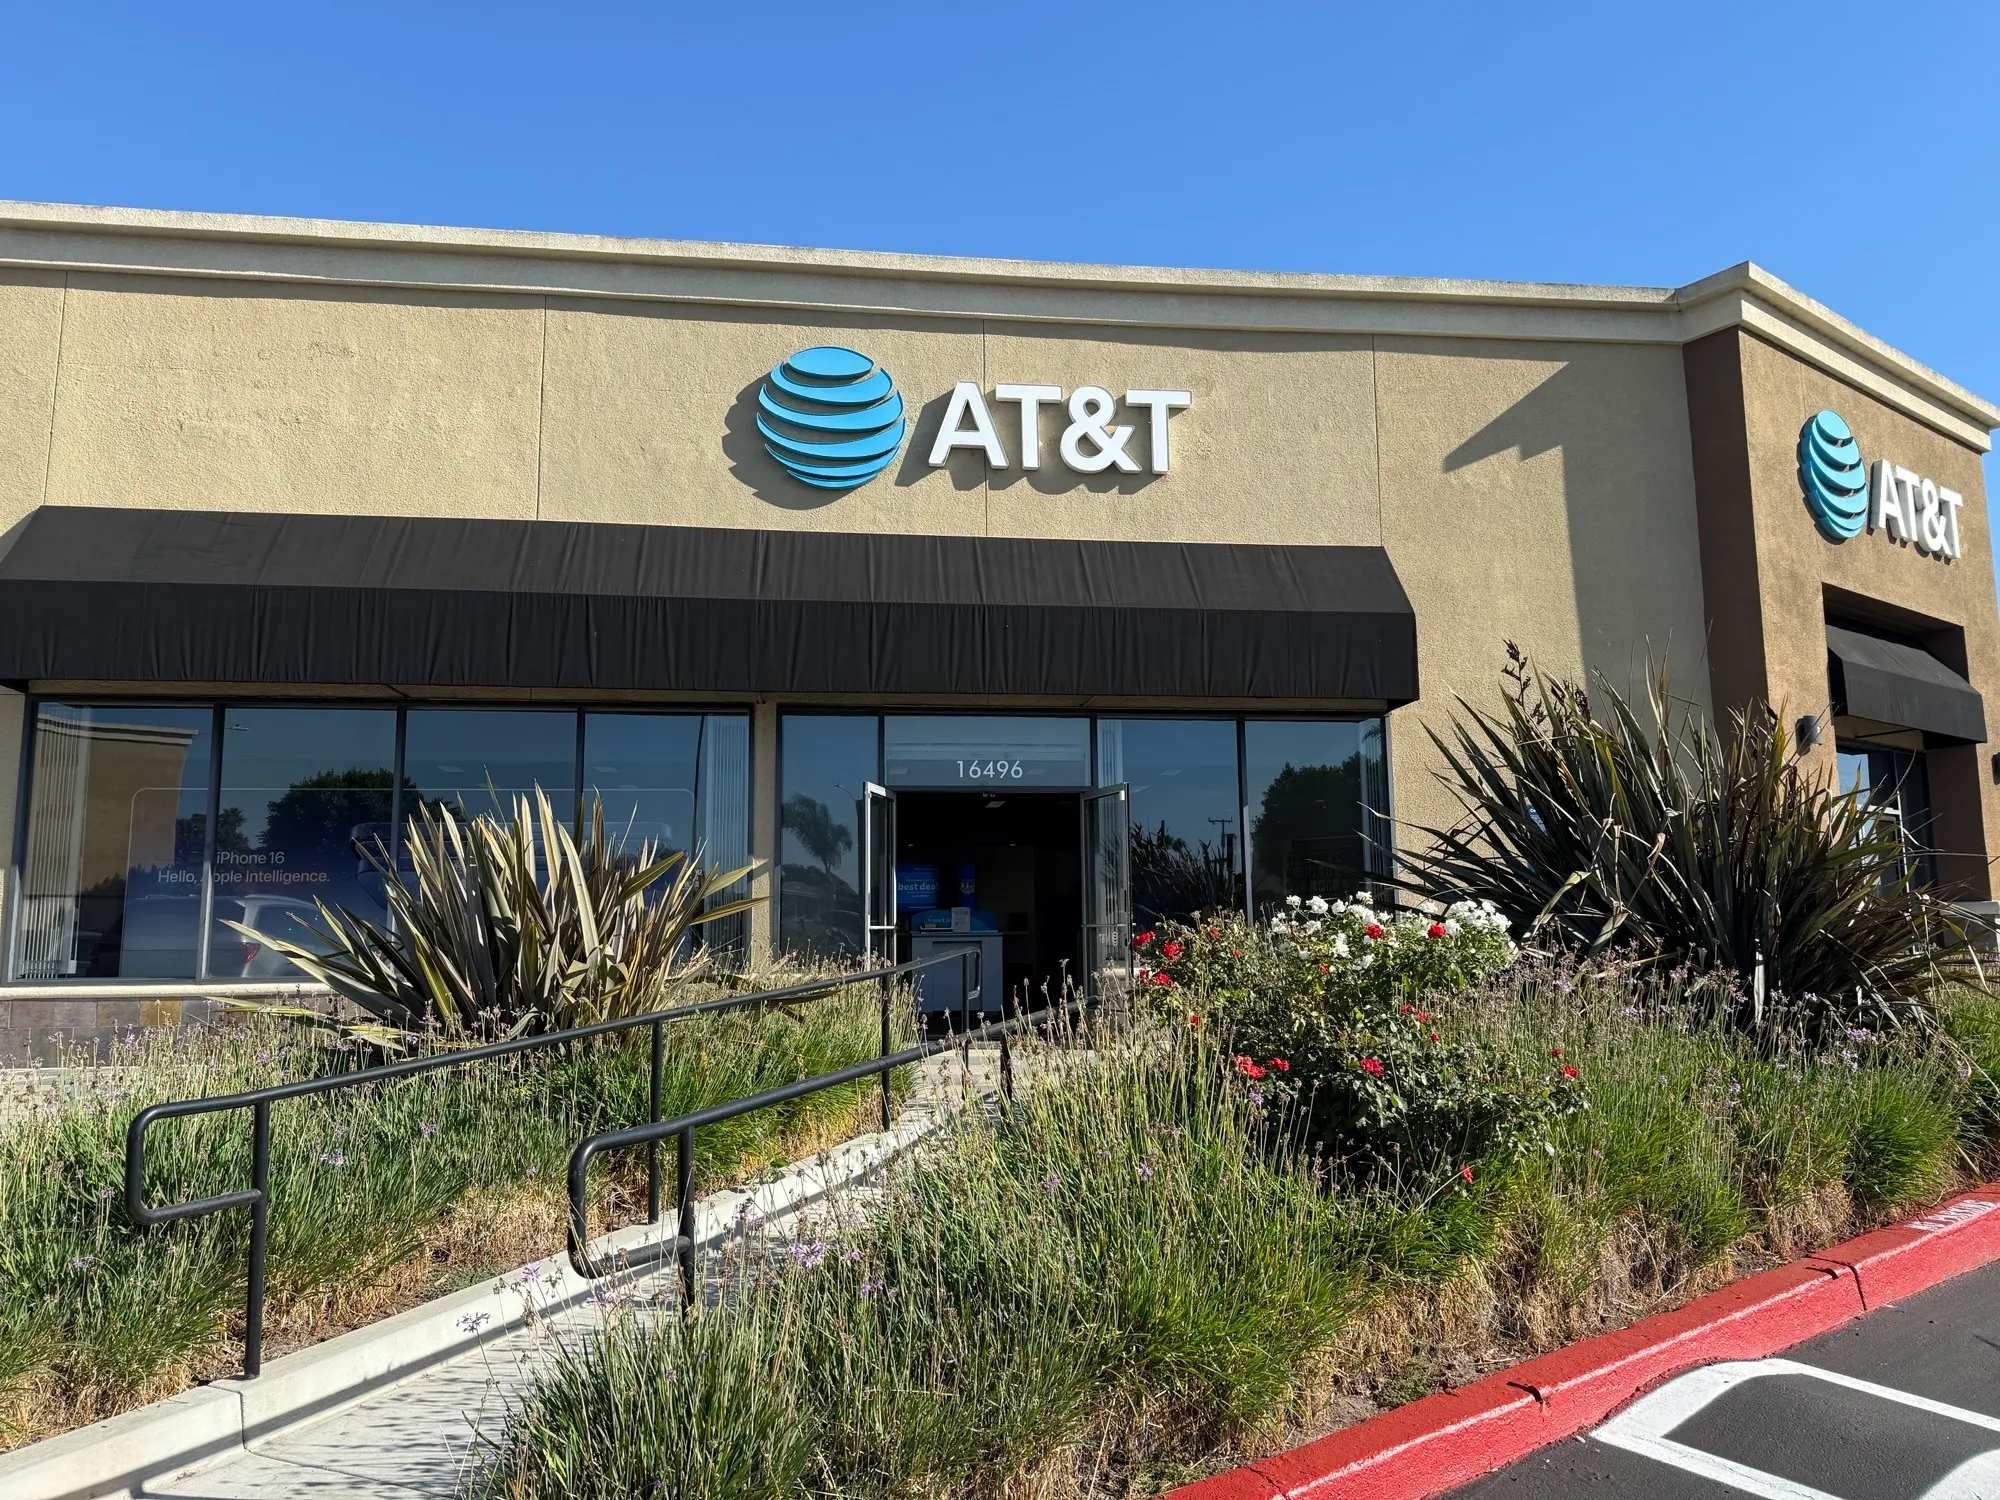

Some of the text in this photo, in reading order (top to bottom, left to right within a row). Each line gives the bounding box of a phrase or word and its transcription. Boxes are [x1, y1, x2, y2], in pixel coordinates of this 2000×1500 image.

[928, 381, 1193, 475] AT&T
[1871, 458, 1963, 559] AT&T
[956, 760, 1023, 779] 16496
[216, 851, 285, 864] iPhone 16
[158, 870, 331, 885] Hello, pple Intelligence.
[898, 882, 942, 891] best deal
